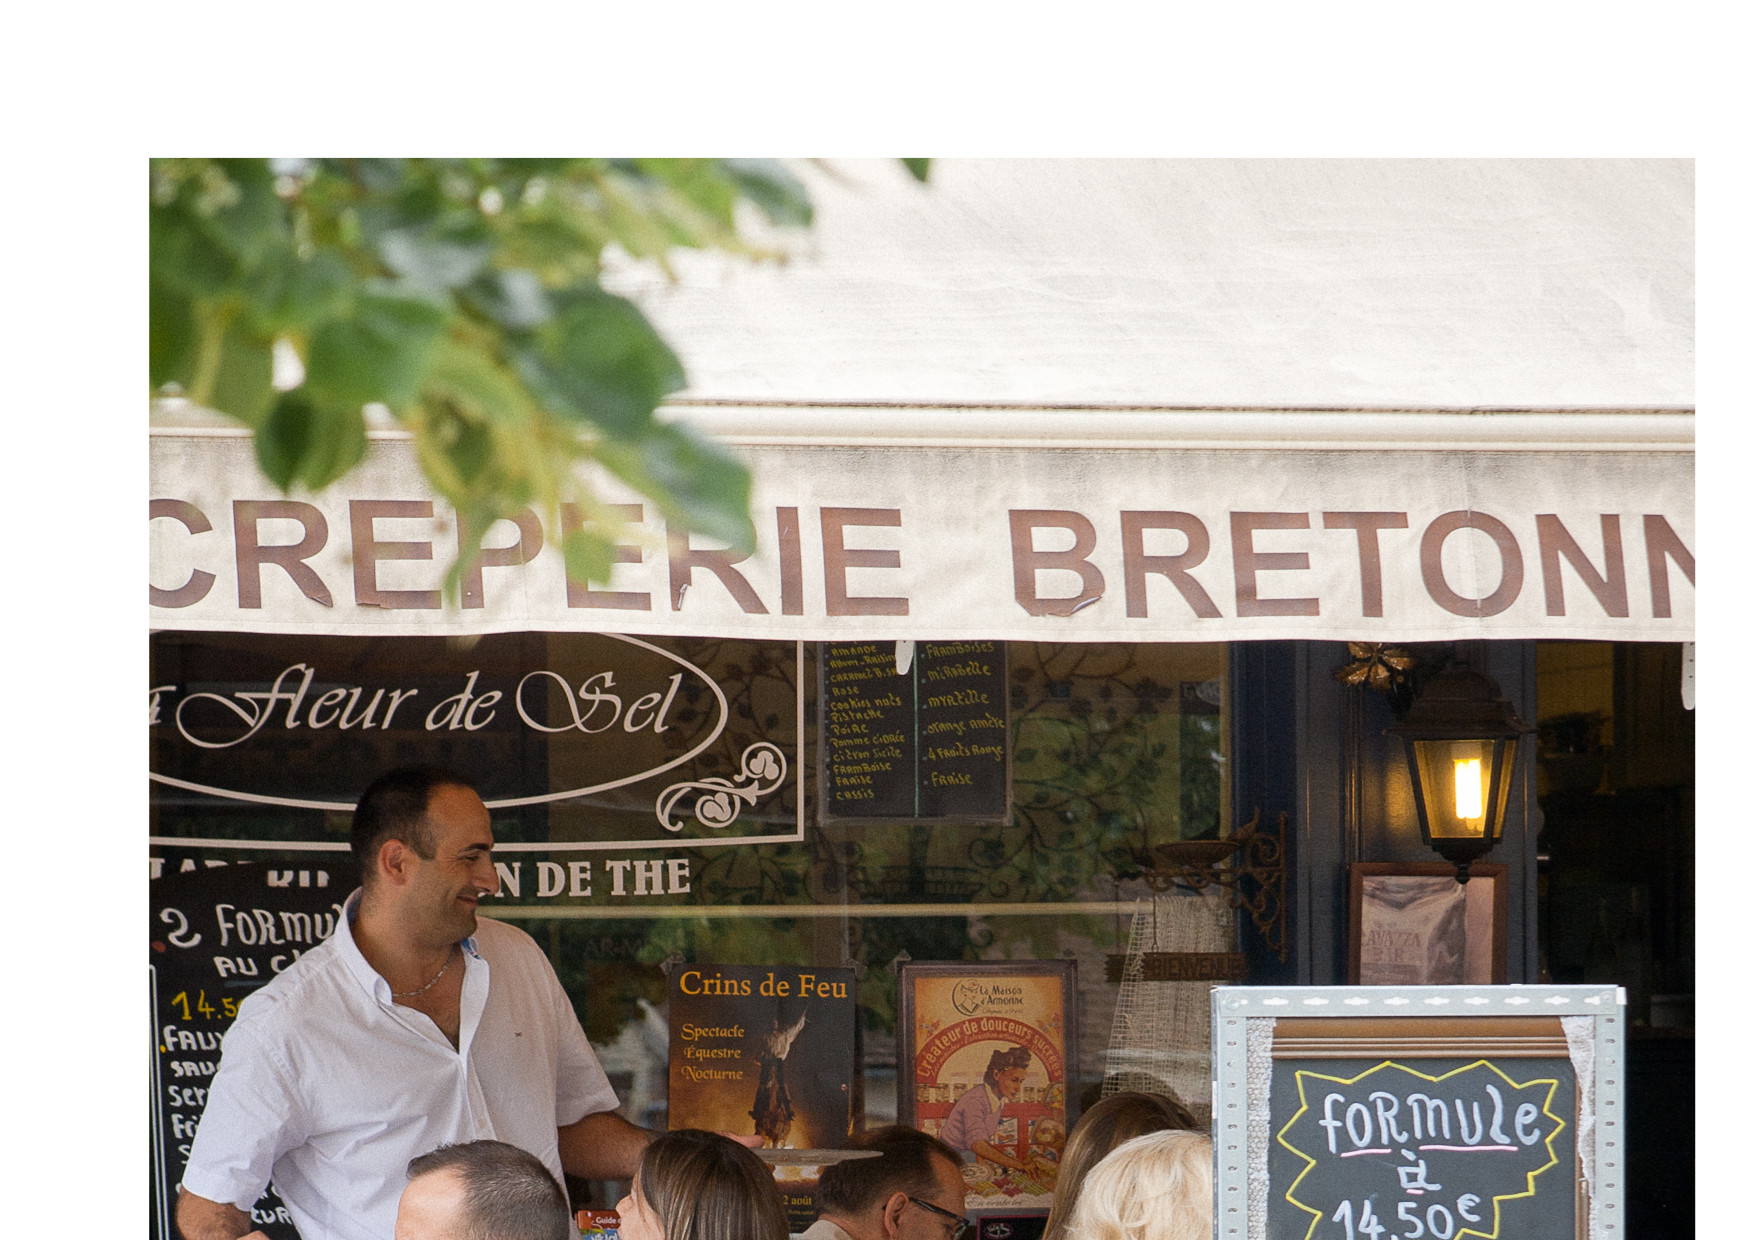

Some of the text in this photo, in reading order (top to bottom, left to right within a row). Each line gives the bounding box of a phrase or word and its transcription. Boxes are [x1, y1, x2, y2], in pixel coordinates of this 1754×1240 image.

[149, 498, 909, 616] CREPERIE
[425, 670, 502, 732] de
[515, 670, 682, 733] Sel
[537, 860, 592, 897] DE
[606, 859, 691, 894] THE
[160, 904, 342, 948] 2 FORMU
[213, 955, 258, 977] AU
[680, 970, 848, 999] Crins de Feu
[680, 1023, 745, 1042] Spectacle
[963, 1019, 980, 1035] de
[981, 1017, 1032, 1040] douceurs
[684, 1046, 742, 1063] Équestre
[681, 1065, 744, 1083] Nocturne
